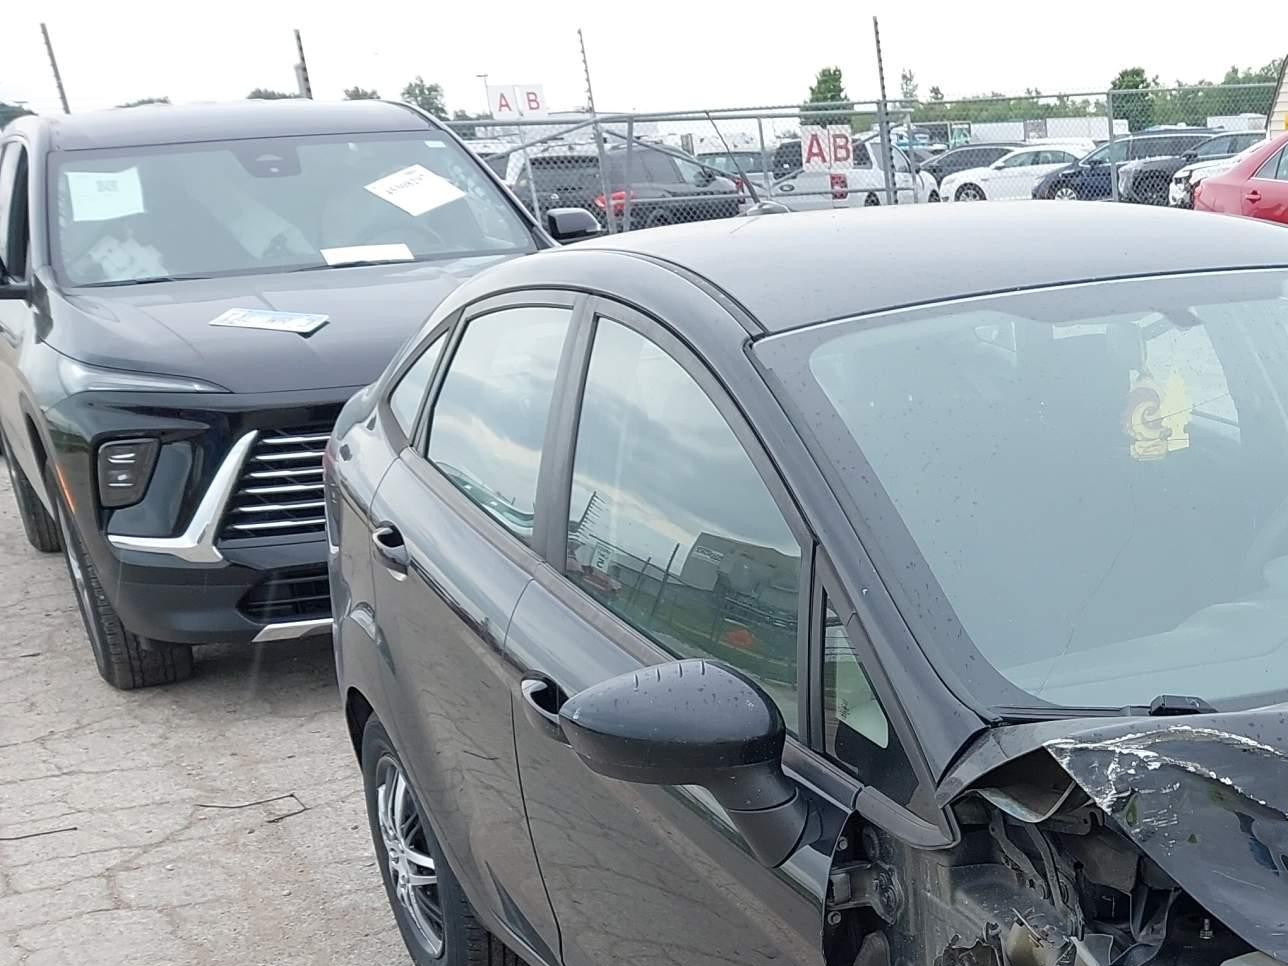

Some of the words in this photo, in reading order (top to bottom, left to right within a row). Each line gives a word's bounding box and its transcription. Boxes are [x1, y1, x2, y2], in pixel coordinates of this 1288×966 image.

[498, 92, 512, 112] A
[526, 91, 540, 110] B
[805, 133, 827, 163] A
[832, 133, 850, 162] B
